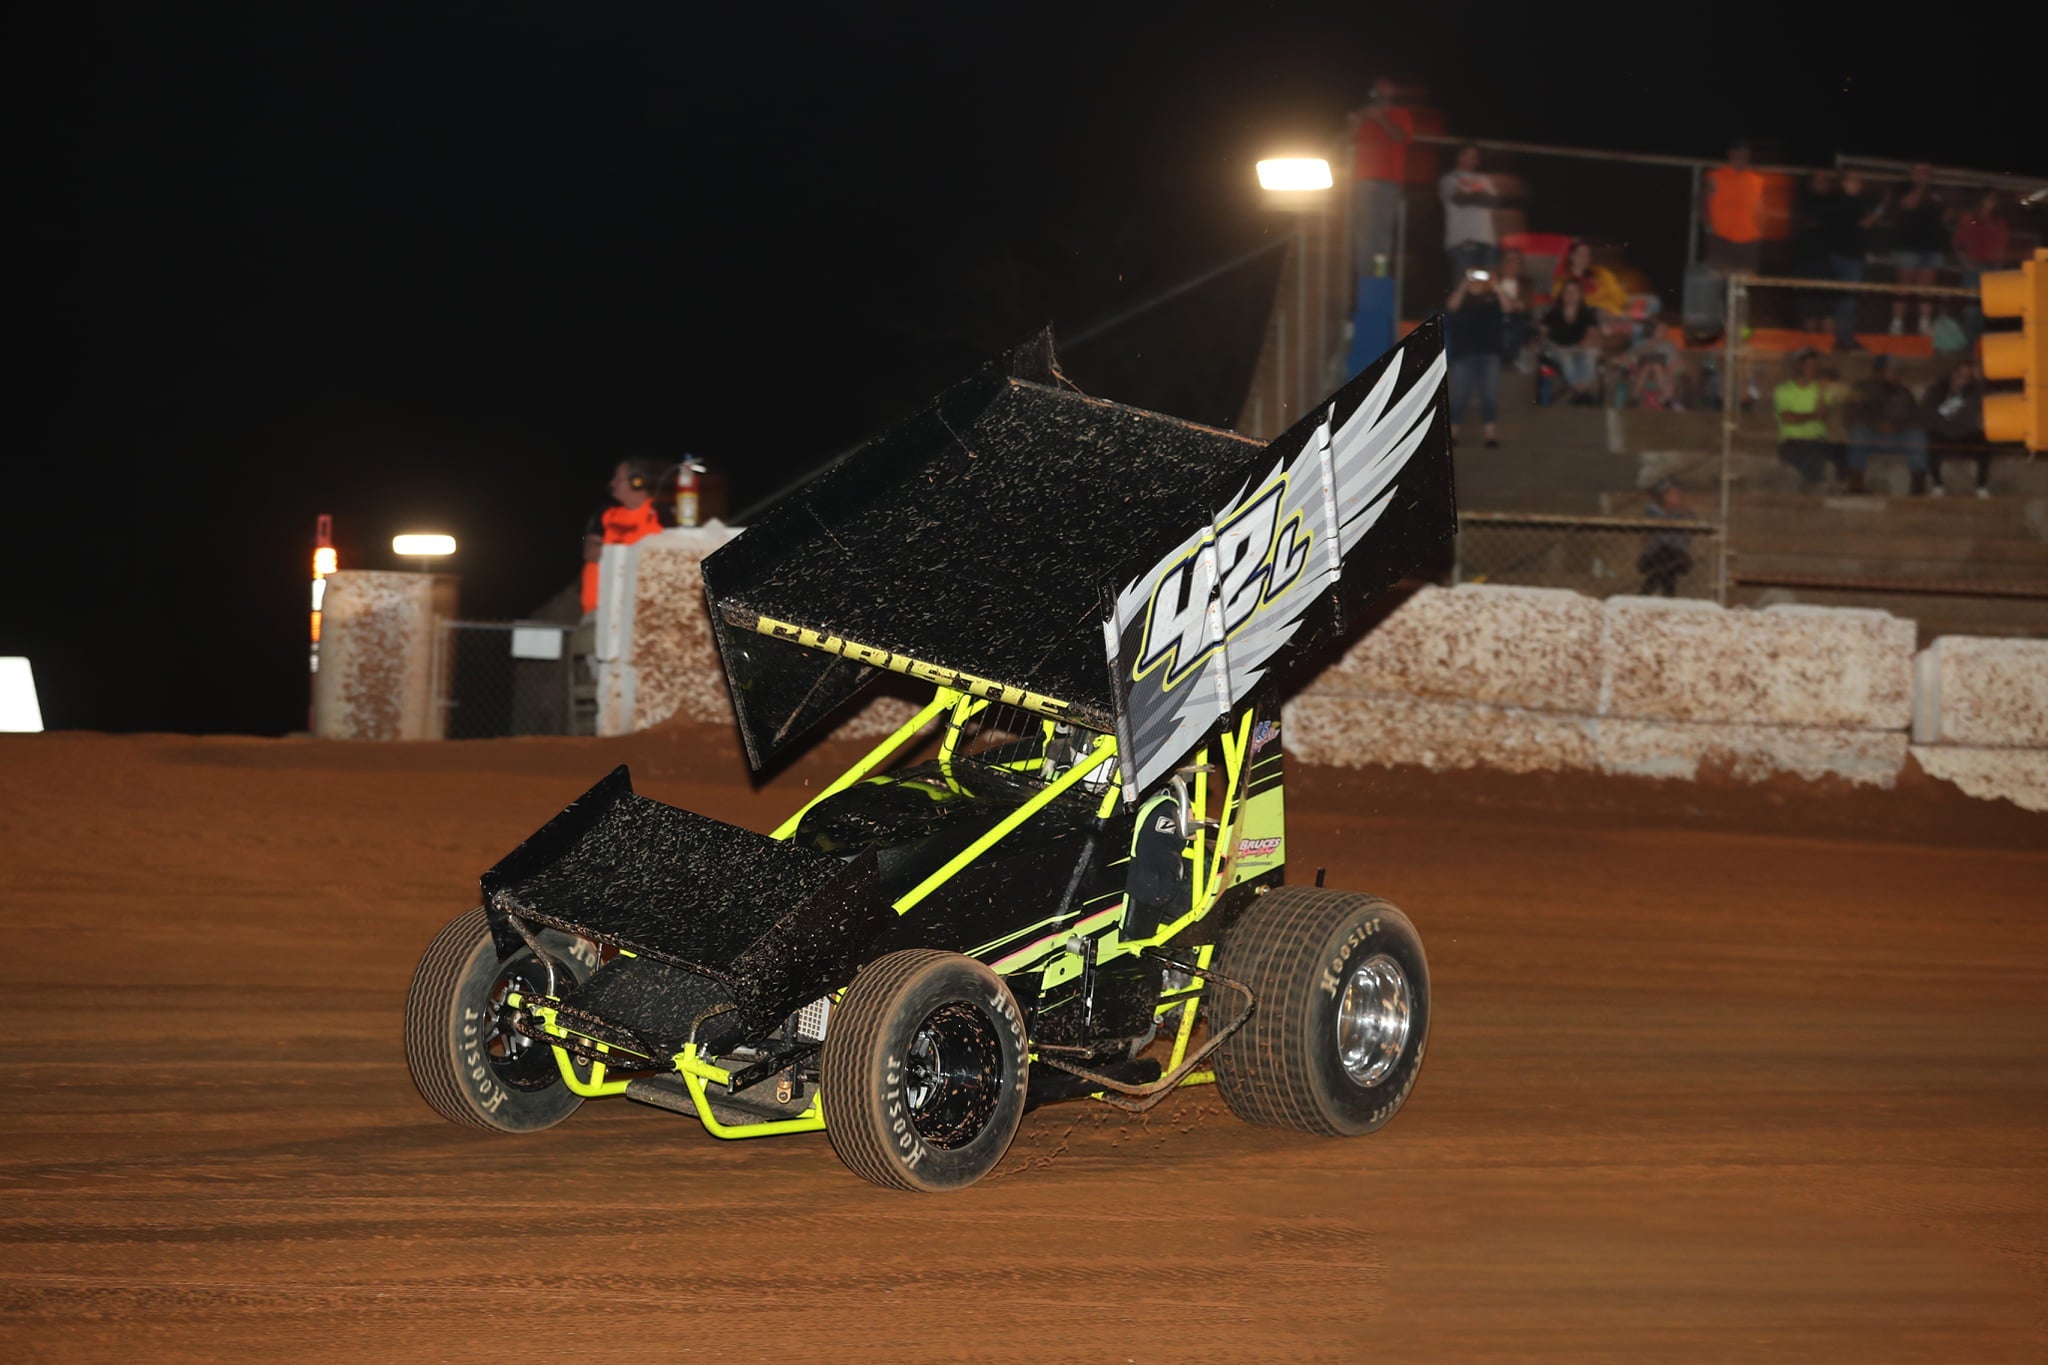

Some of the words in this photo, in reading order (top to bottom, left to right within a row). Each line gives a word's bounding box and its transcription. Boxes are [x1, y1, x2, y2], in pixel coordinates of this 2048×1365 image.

[1321, 917, 1381, 999] Hoosier
[460, 1007, 508, 1113] Hoosier
[882, 1055, 927, 1169] Hoosier
